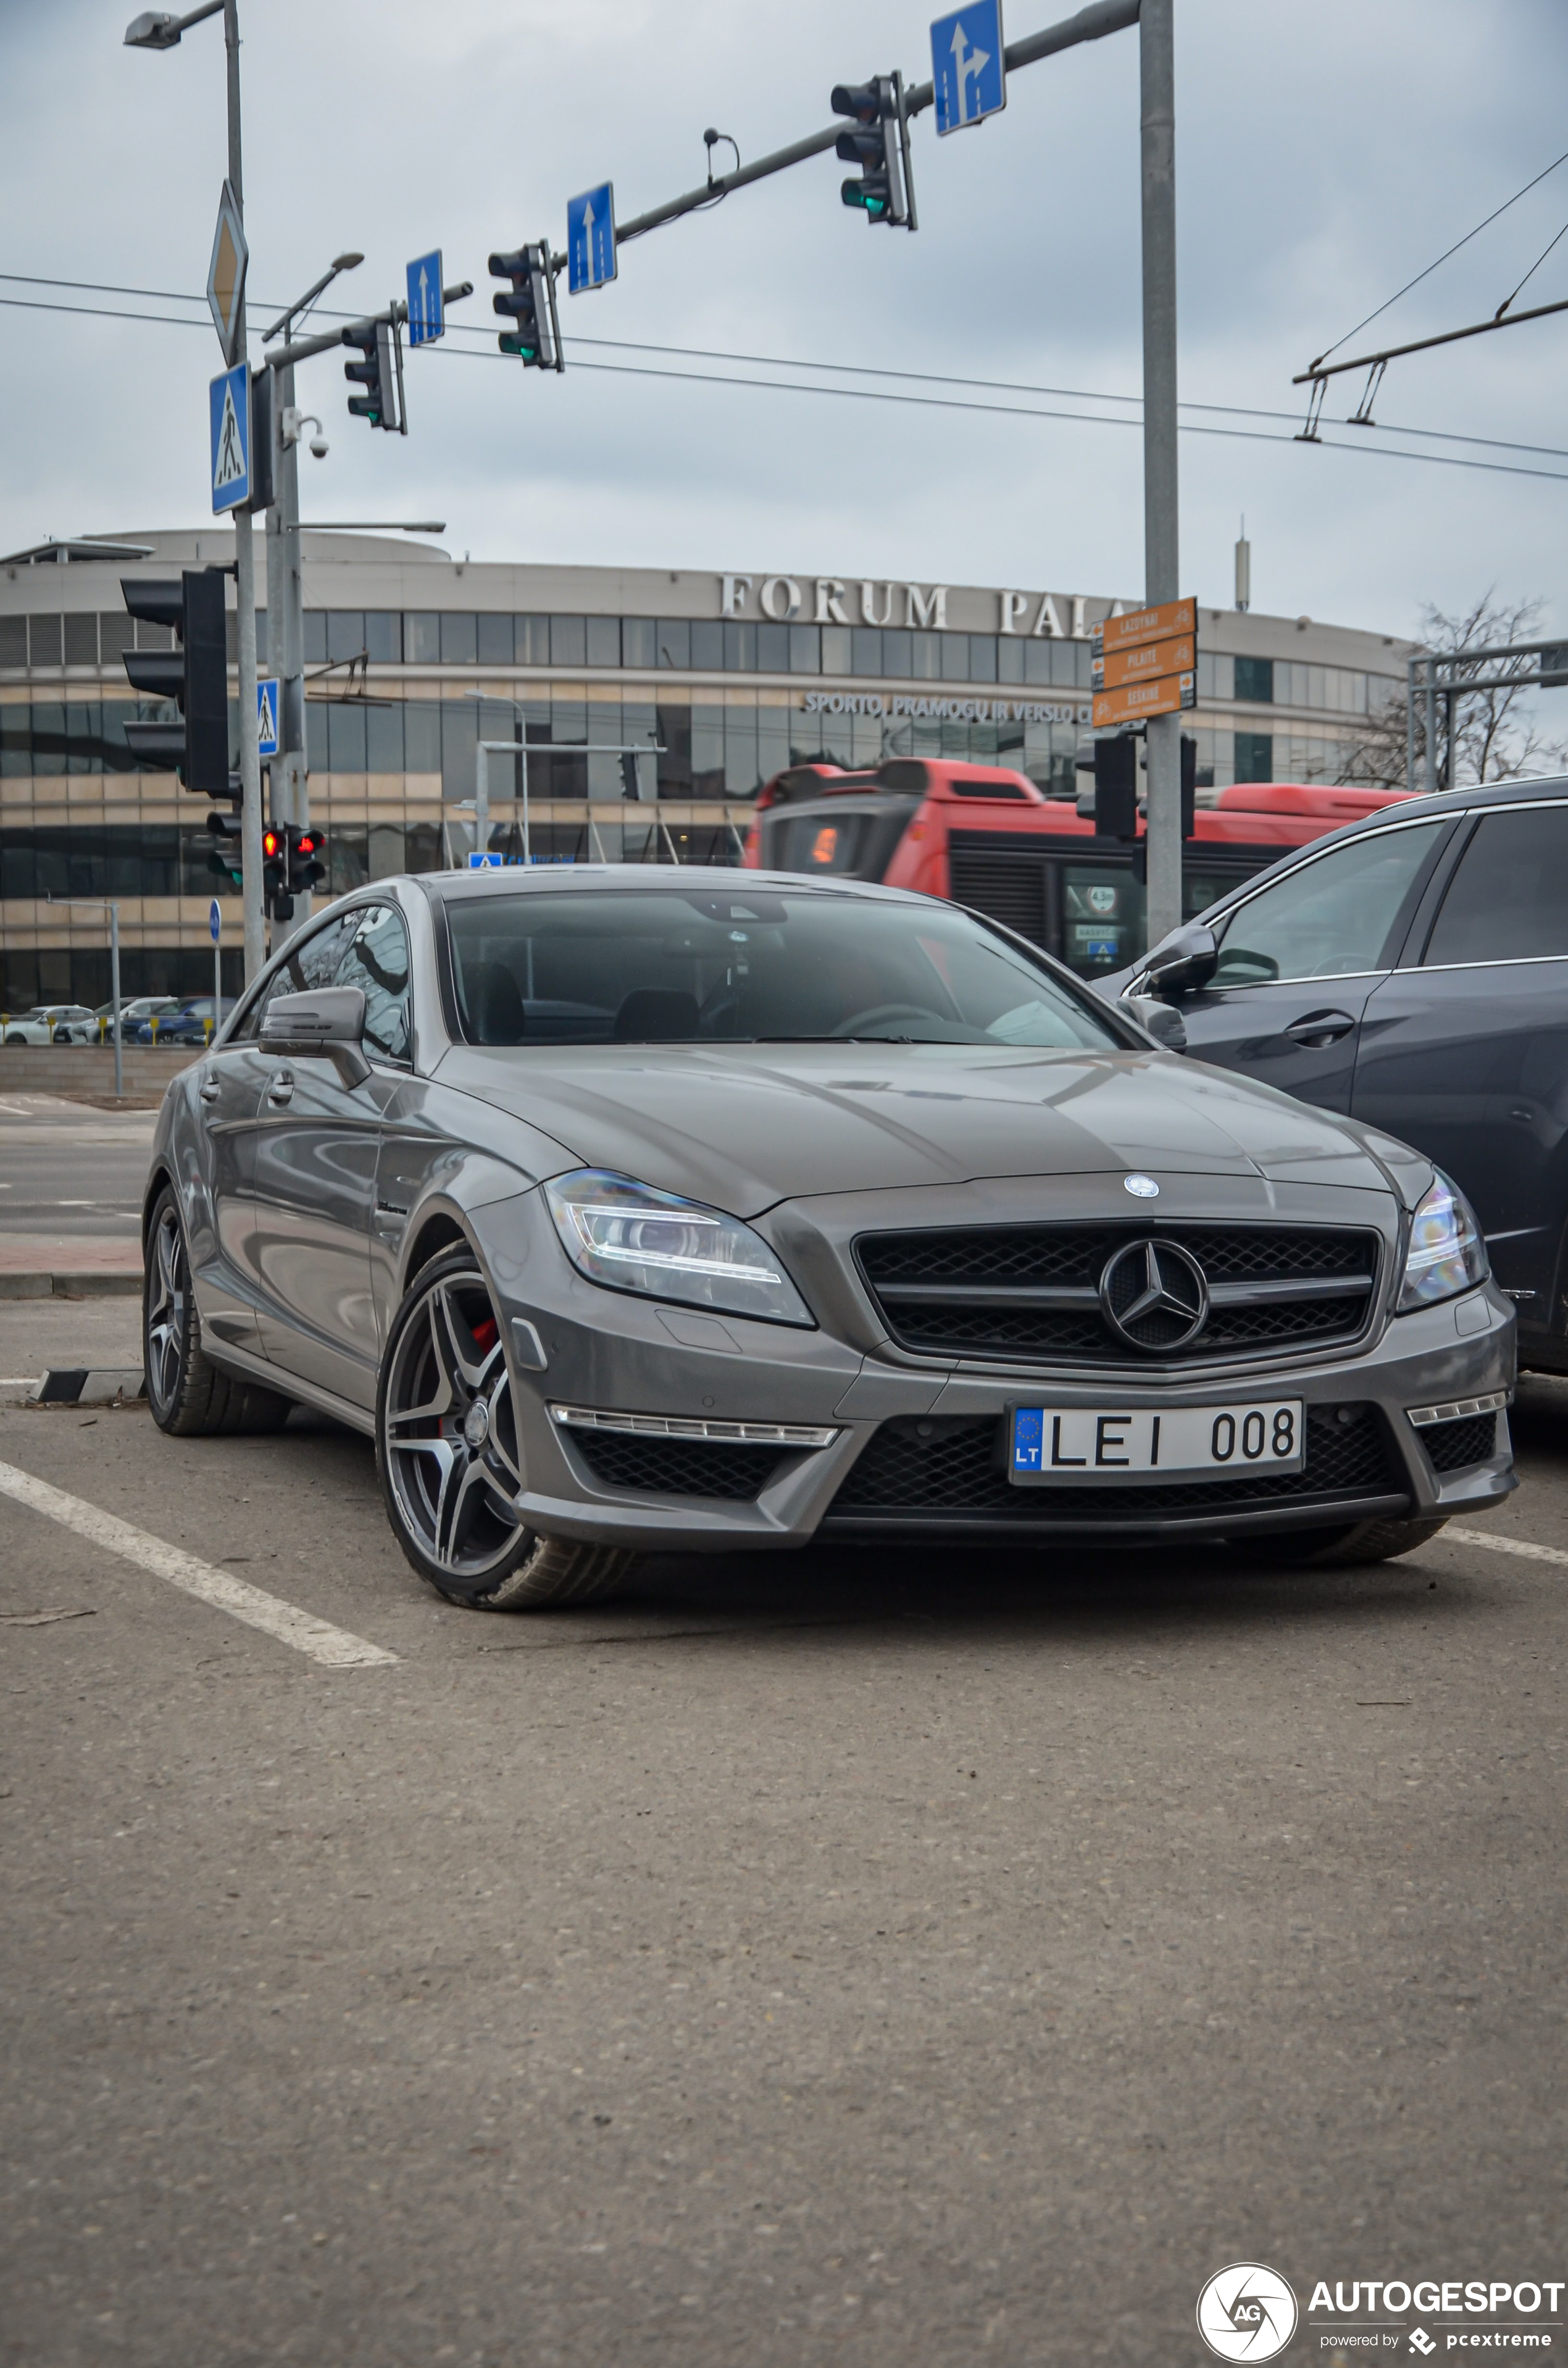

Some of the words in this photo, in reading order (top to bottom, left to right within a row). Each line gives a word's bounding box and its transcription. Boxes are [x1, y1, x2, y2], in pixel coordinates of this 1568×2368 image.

[719, 574, 950, 629] FORUM
[893, 695, 988, 723] PRAMOGŲ
[992, 700, 1009, 719] IR
[1012, 701, 1074, 723] VERSLO
[1016, 1448, 1038, 1462] LT
[1051, 1415, 1161, 1466] LEI
[1211, 1407, 1294, 1462] 008
